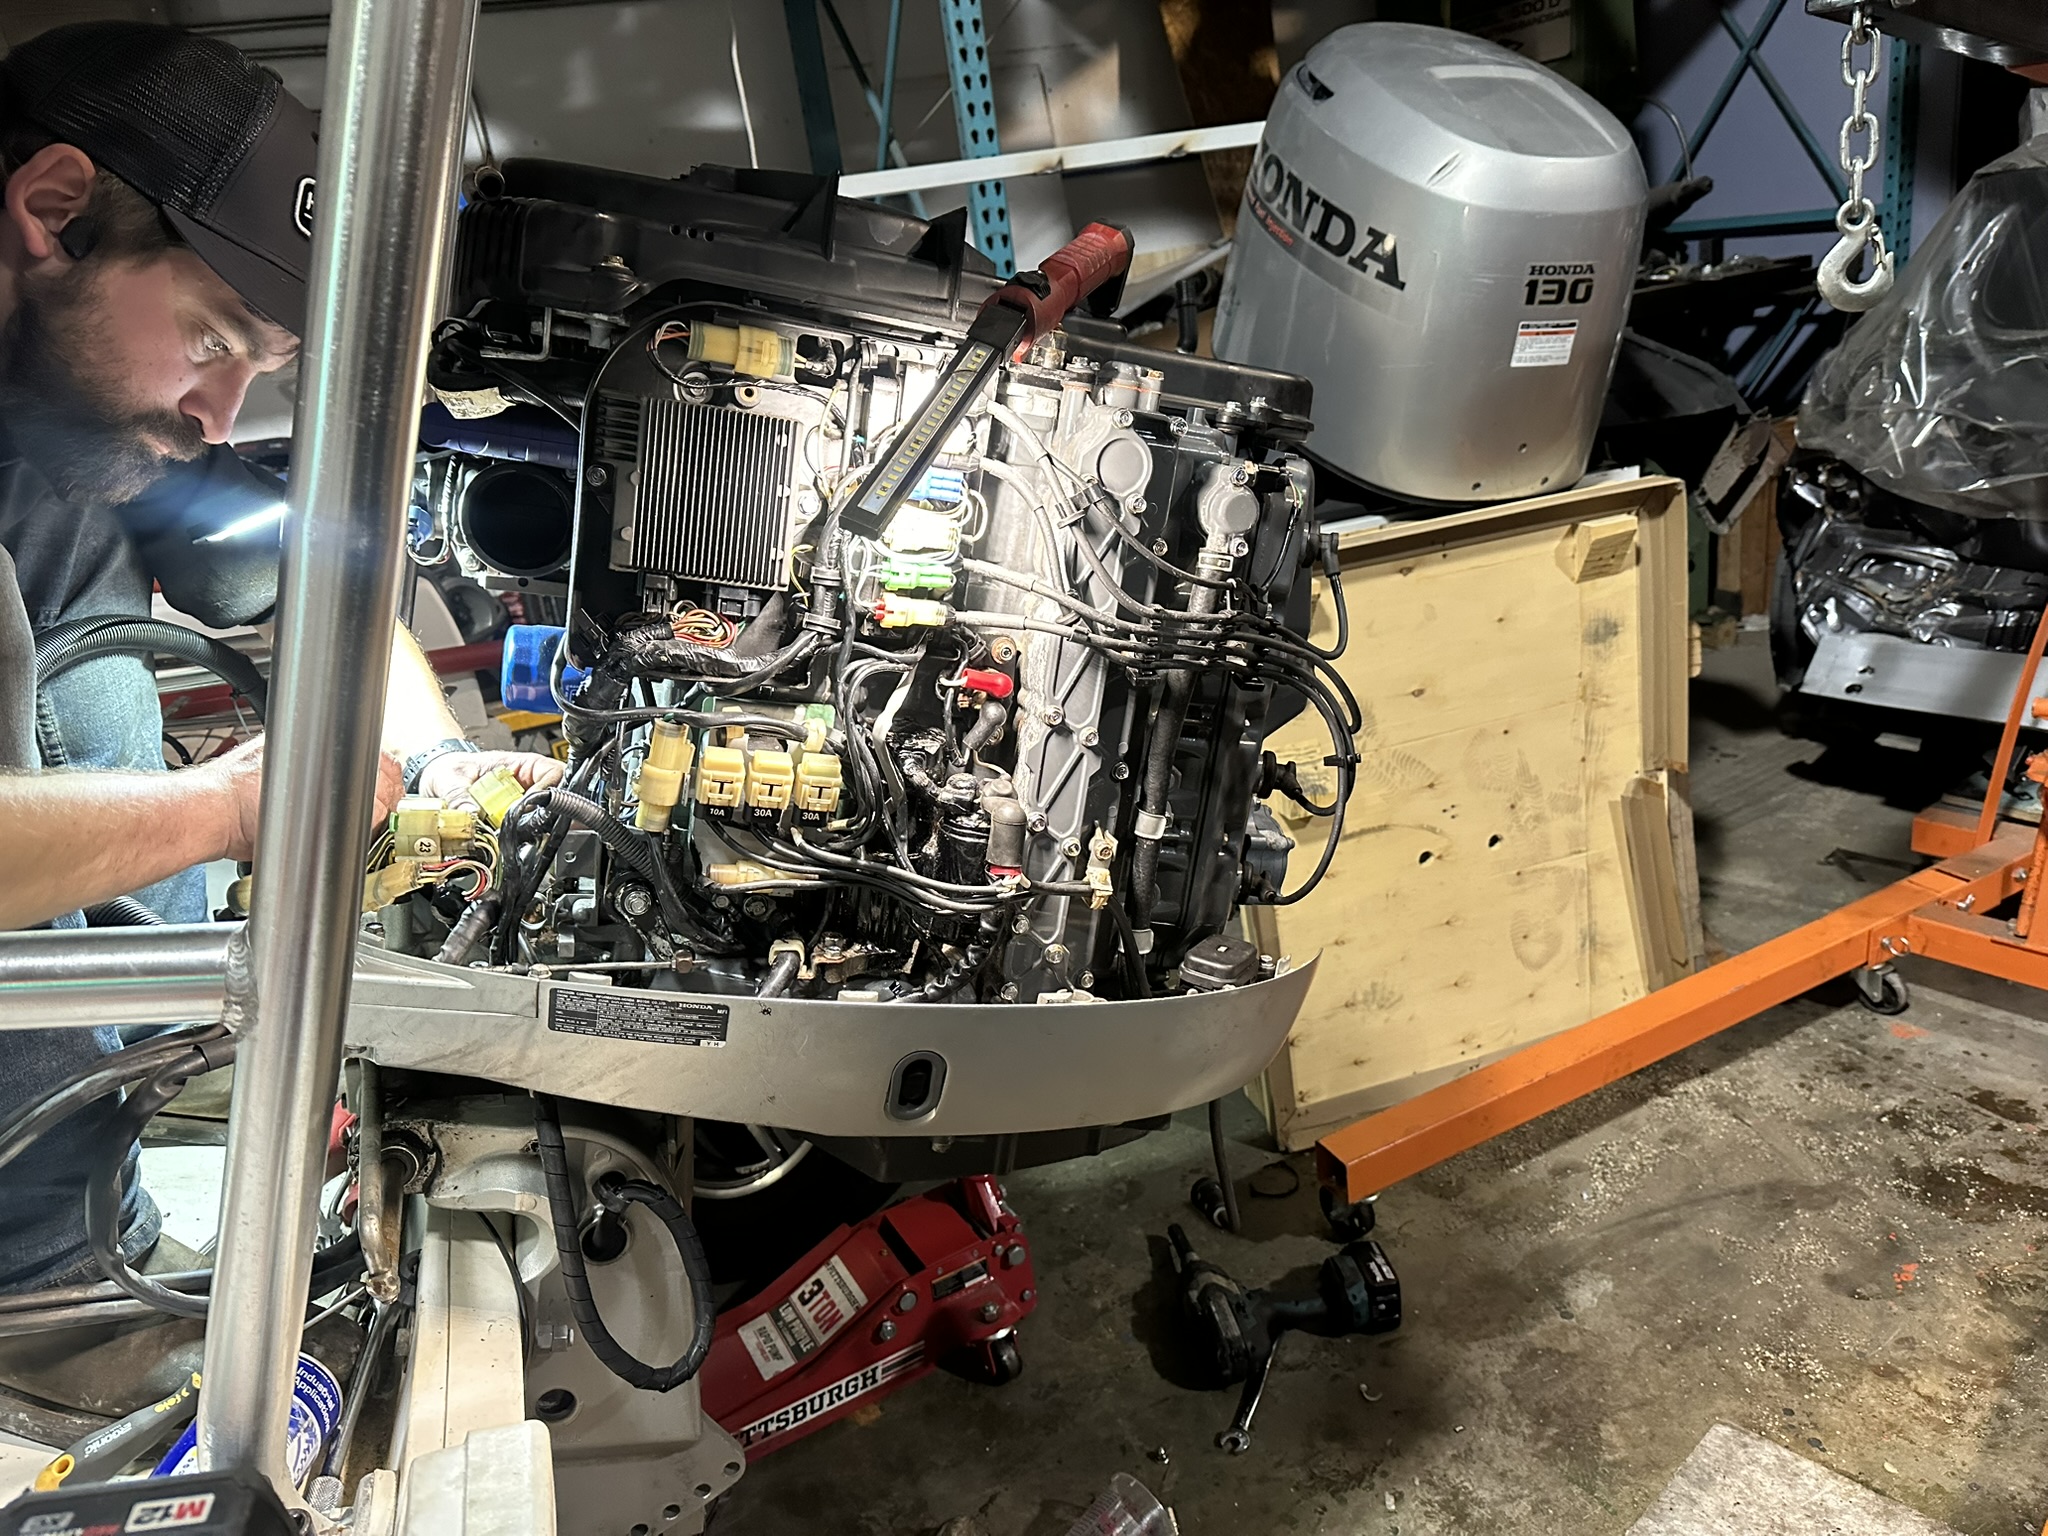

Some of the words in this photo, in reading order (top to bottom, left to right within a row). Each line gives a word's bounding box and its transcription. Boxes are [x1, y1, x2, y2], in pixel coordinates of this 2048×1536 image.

[1529, 264, 1595, 276] HONDA
[1525, 278, 1594, 305] 130
[709, 808, 725, 816] 10A
[753, 808, 773, 817] 30A
[802, 812, 820, 820] 30A
[419, 841, 431, 853] 23
[678, 1002, 713, 1011] HONDA
[797, 1278, 824, 1306] 3
[808, 1289, 844, 1335] TON
[297, 1367, 335, 1410] Industrial
[731, 1366, 879, 1447] TTSBURGH
[133, 1499, 207, 1524] M12
